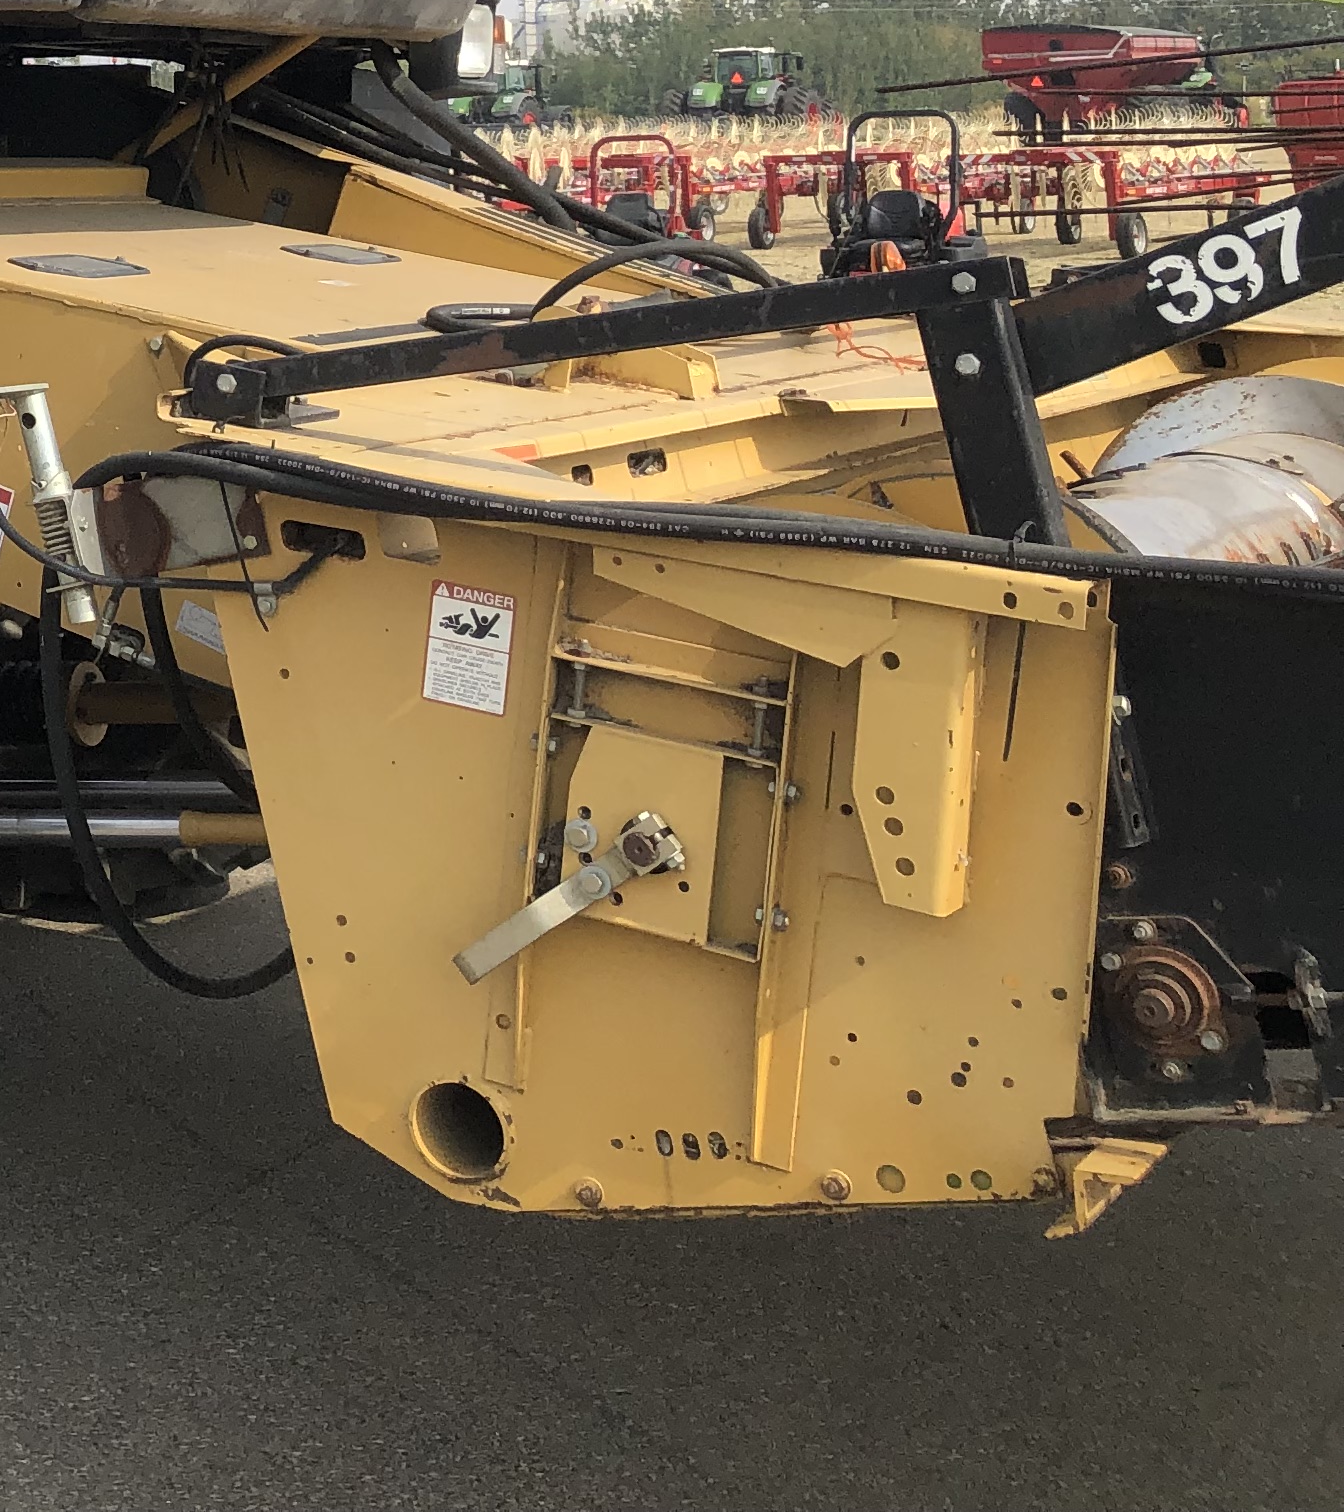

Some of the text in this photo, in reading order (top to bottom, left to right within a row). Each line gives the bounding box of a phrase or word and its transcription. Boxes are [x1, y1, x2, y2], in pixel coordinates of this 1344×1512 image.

[1146, 206, 1303, 324] 397
[667, 523, 690, 533] CAT
[453, 585, 514, 609] DANGER
